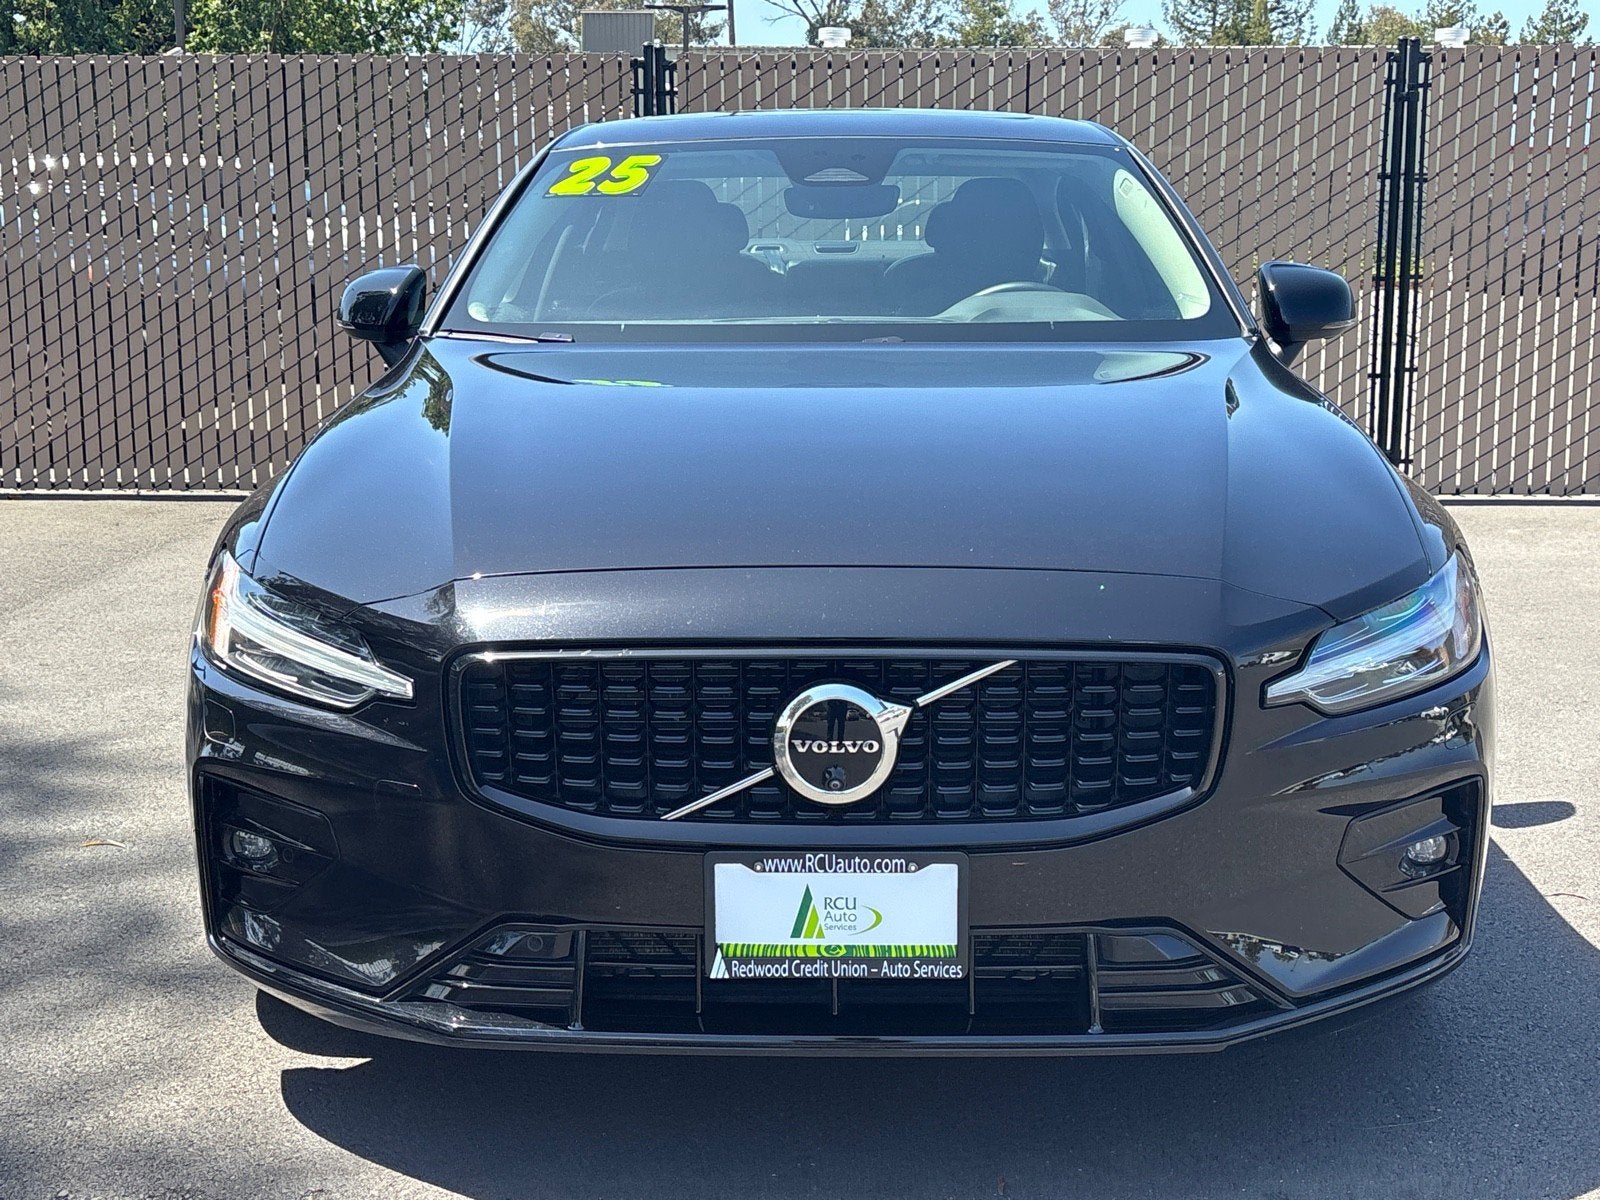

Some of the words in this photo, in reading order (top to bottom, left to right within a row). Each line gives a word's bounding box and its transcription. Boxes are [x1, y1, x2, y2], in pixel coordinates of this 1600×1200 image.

[549, 155, 662, 195] 25
[791, 740, 880, 754] VOLVO
[764, 854, 906, 873] www.RCUauto.com
[824, 897, 857, 911] RCU
[824, 911, 857, 923] Auto
[824, 923, 857, 931] Services
[732, 961, 789, 978] Redwood
[792, 961, 829, 978] Credit
[831, 961, 867, 977] Union
[881, 962, 911, 978] Auto
[914, 961, 962, 978] Services
